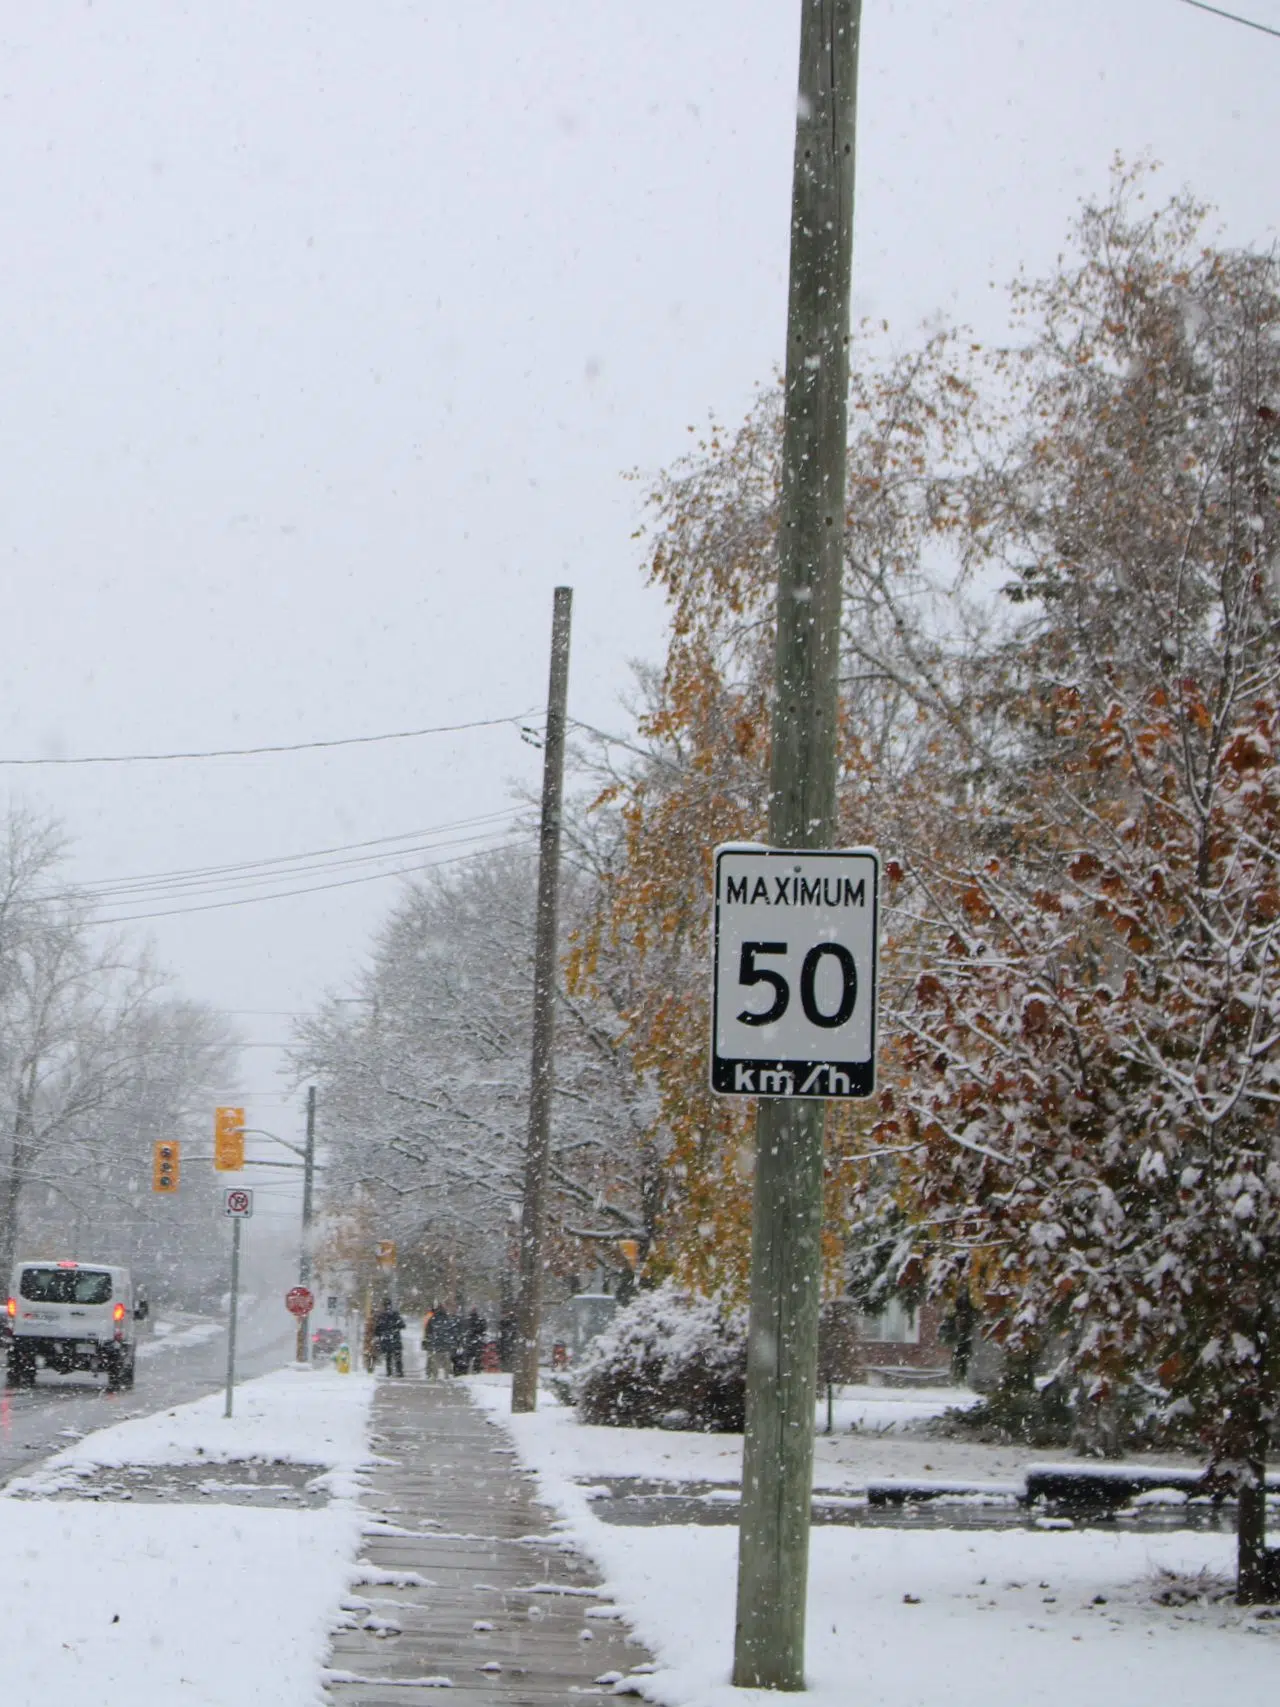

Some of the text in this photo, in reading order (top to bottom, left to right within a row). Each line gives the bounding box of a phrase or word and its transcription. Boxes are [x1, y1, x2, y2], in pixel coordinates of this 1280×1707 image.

[726, 876, 865, 907] MAXIMUM
[736, 941, 858, 1029] 50
[734, 1062, 850, 1095] km/h
